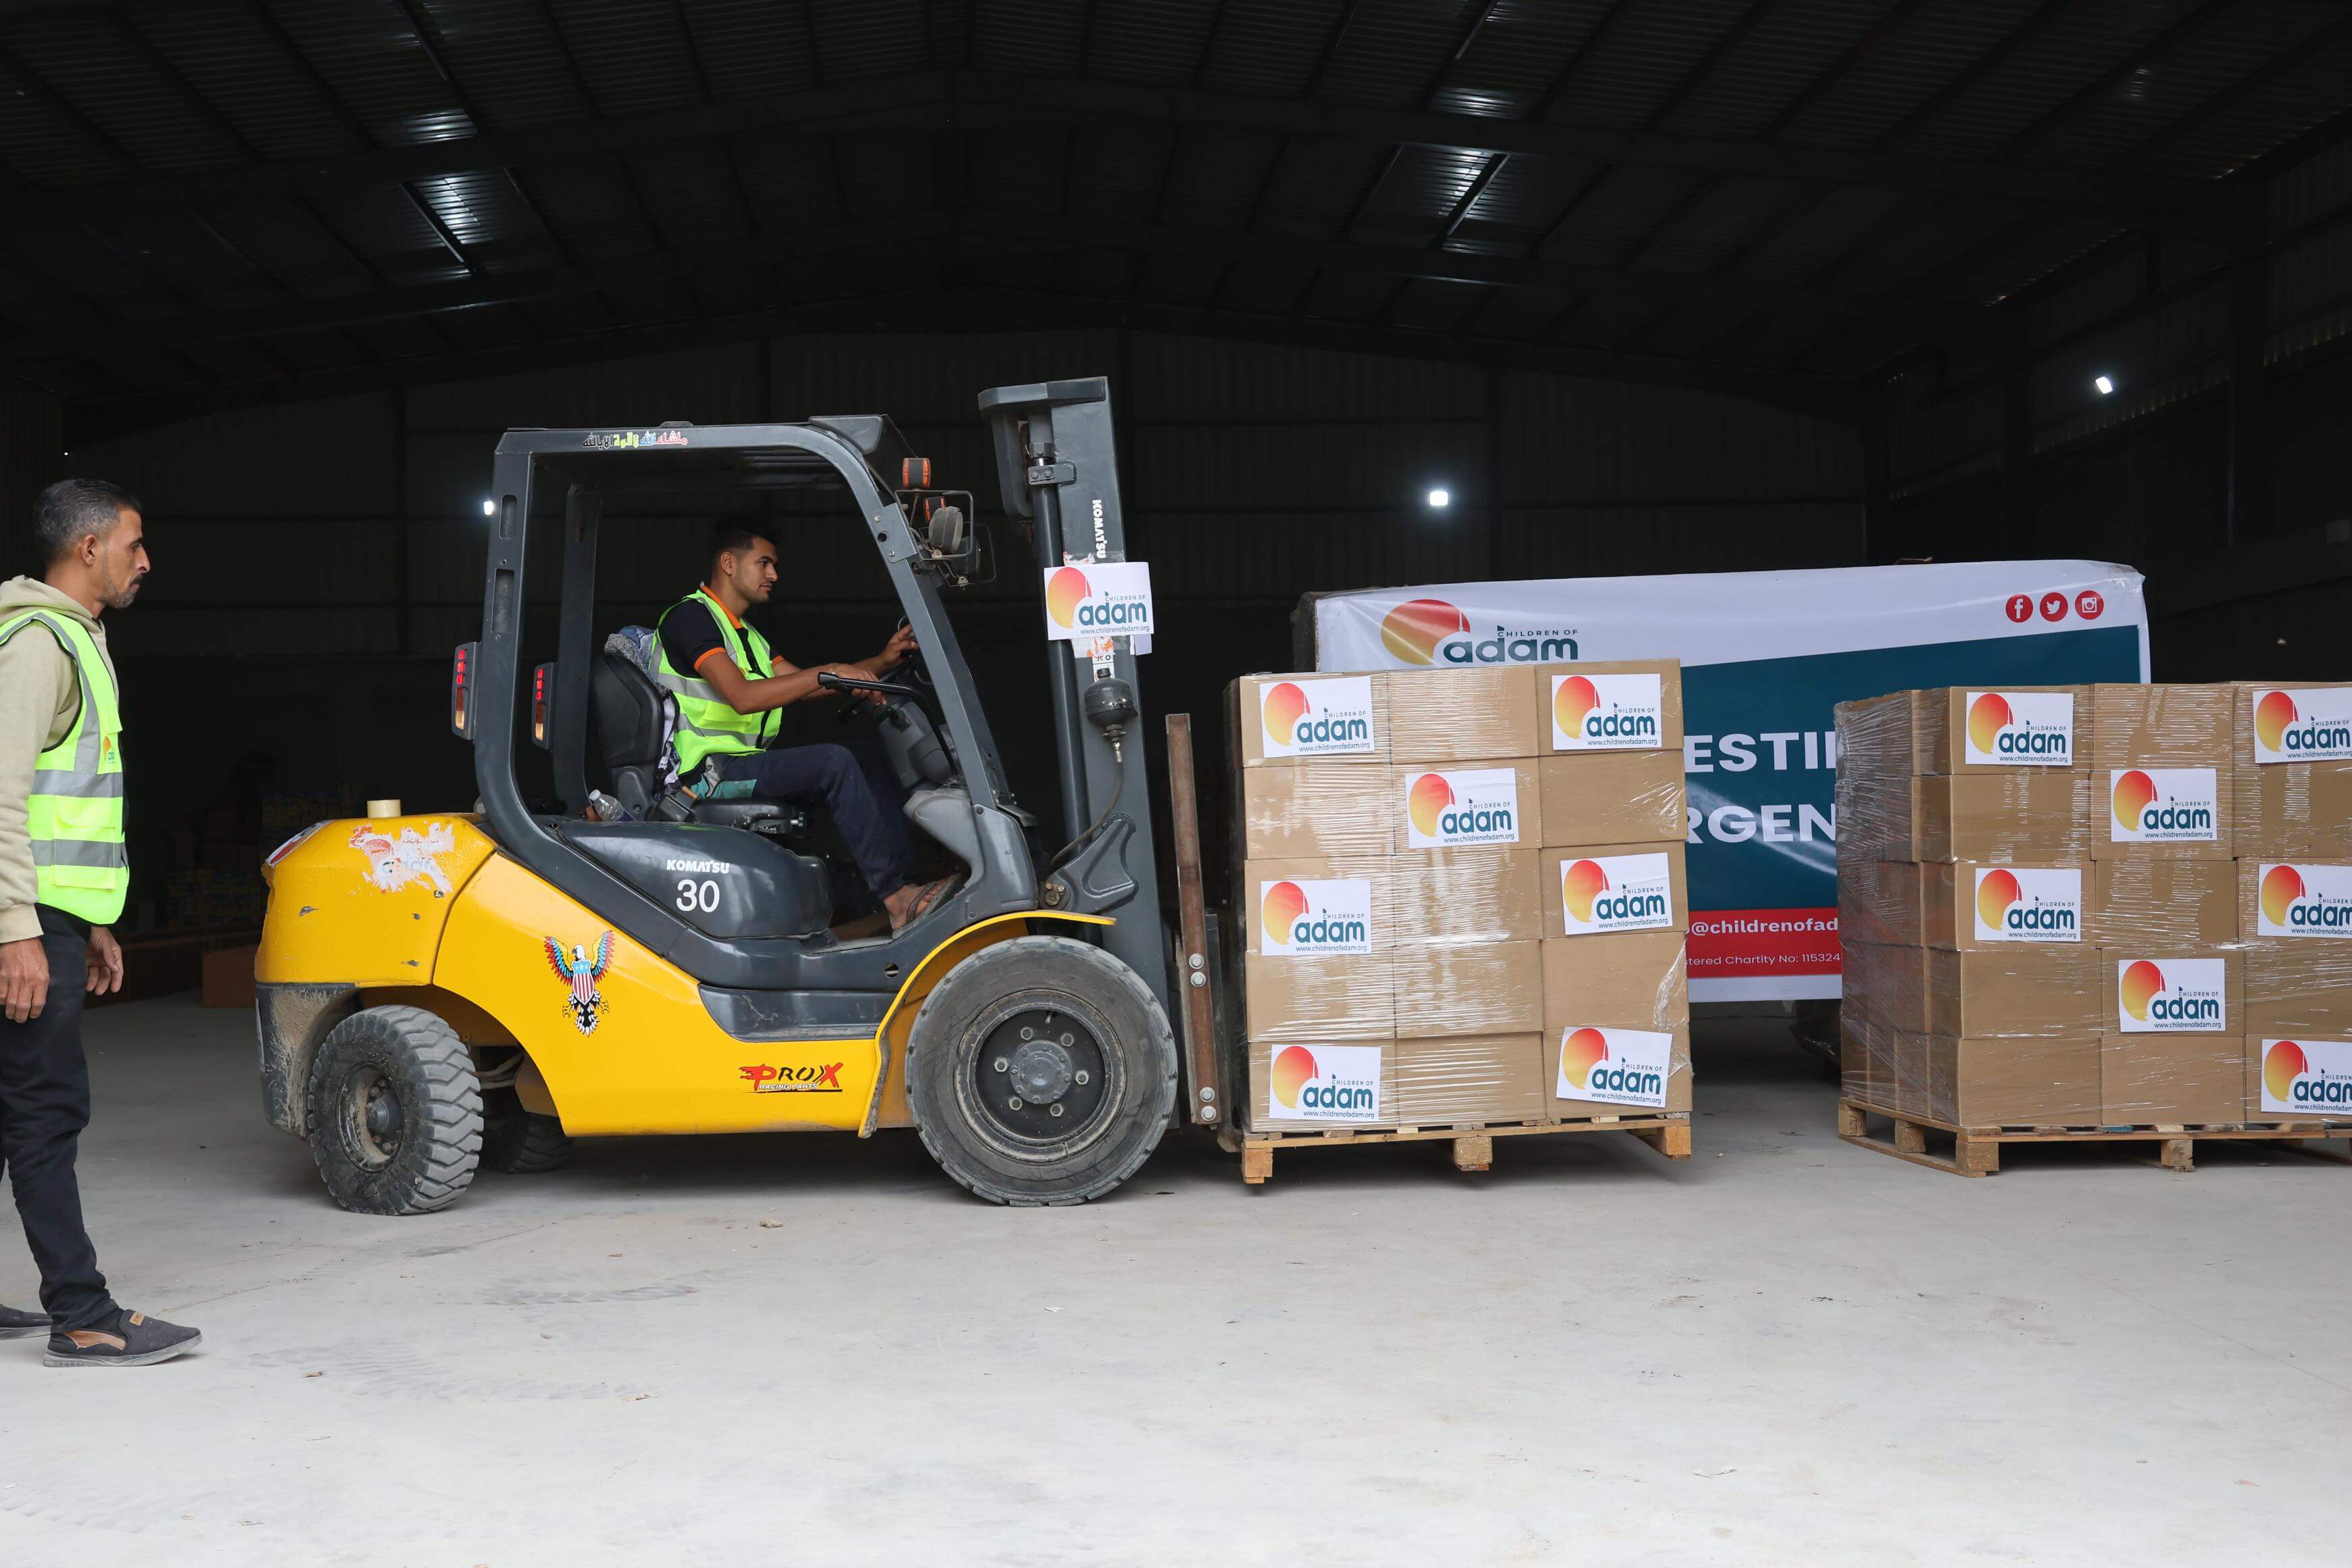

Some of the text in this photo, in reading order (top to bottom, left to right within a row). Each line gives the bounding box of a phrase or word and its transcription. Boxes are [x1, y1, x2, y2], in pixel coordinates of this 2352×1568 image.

[1092, 499, 1108, 559] KOMATSU
[1079, 602, 1147, 627] adam
[1081, 625, 1150, 635] www.childrenofadam.org
[1444, 637, 1579, 662] adam
[1325, 710, 1356, 718] CHILDREN
[1586, 714, 1655, 737] adam
[1297, 718, 1367, 743] adam
[2286, 727, 2351, 750] adam
[1299, 743, 1371, 752] www.childrenofadam.org
[1999, 731, 2066, 754] adam
[1442, 810, 1512, 834] adam
[2144, 807, 2211, 830] adam
[1444, 834, 1515, 843] www.childrenofadam.org
[666, 859, 731, 874] KOMATSU
[677, 879, 720, 913] 30
[1596, 895, 1665, 920] adam
[1598, 918, 1668, 929] www.childrenofadam.org
[2007, 907, 2074, 929] adam
[1294, 920, 1365, 943] adam
[1725, 954, 1775, 965] Chartity
[1779, 954, 1798, 963] No:
[1802, 953, 1843, 962] 115324
[2152, 997, 2220, 1019] adam
[1621, 1063, 1652, 1071] CHILDREN
[1592, 1069, 1661, 1095] adam
[1303, 1085, 1373, 1109] adam
[1591, 1093, 1661, 1104] www.childrenofadam.org
[1303, 1110, 1375, 1119] www.childrenofadam.org
